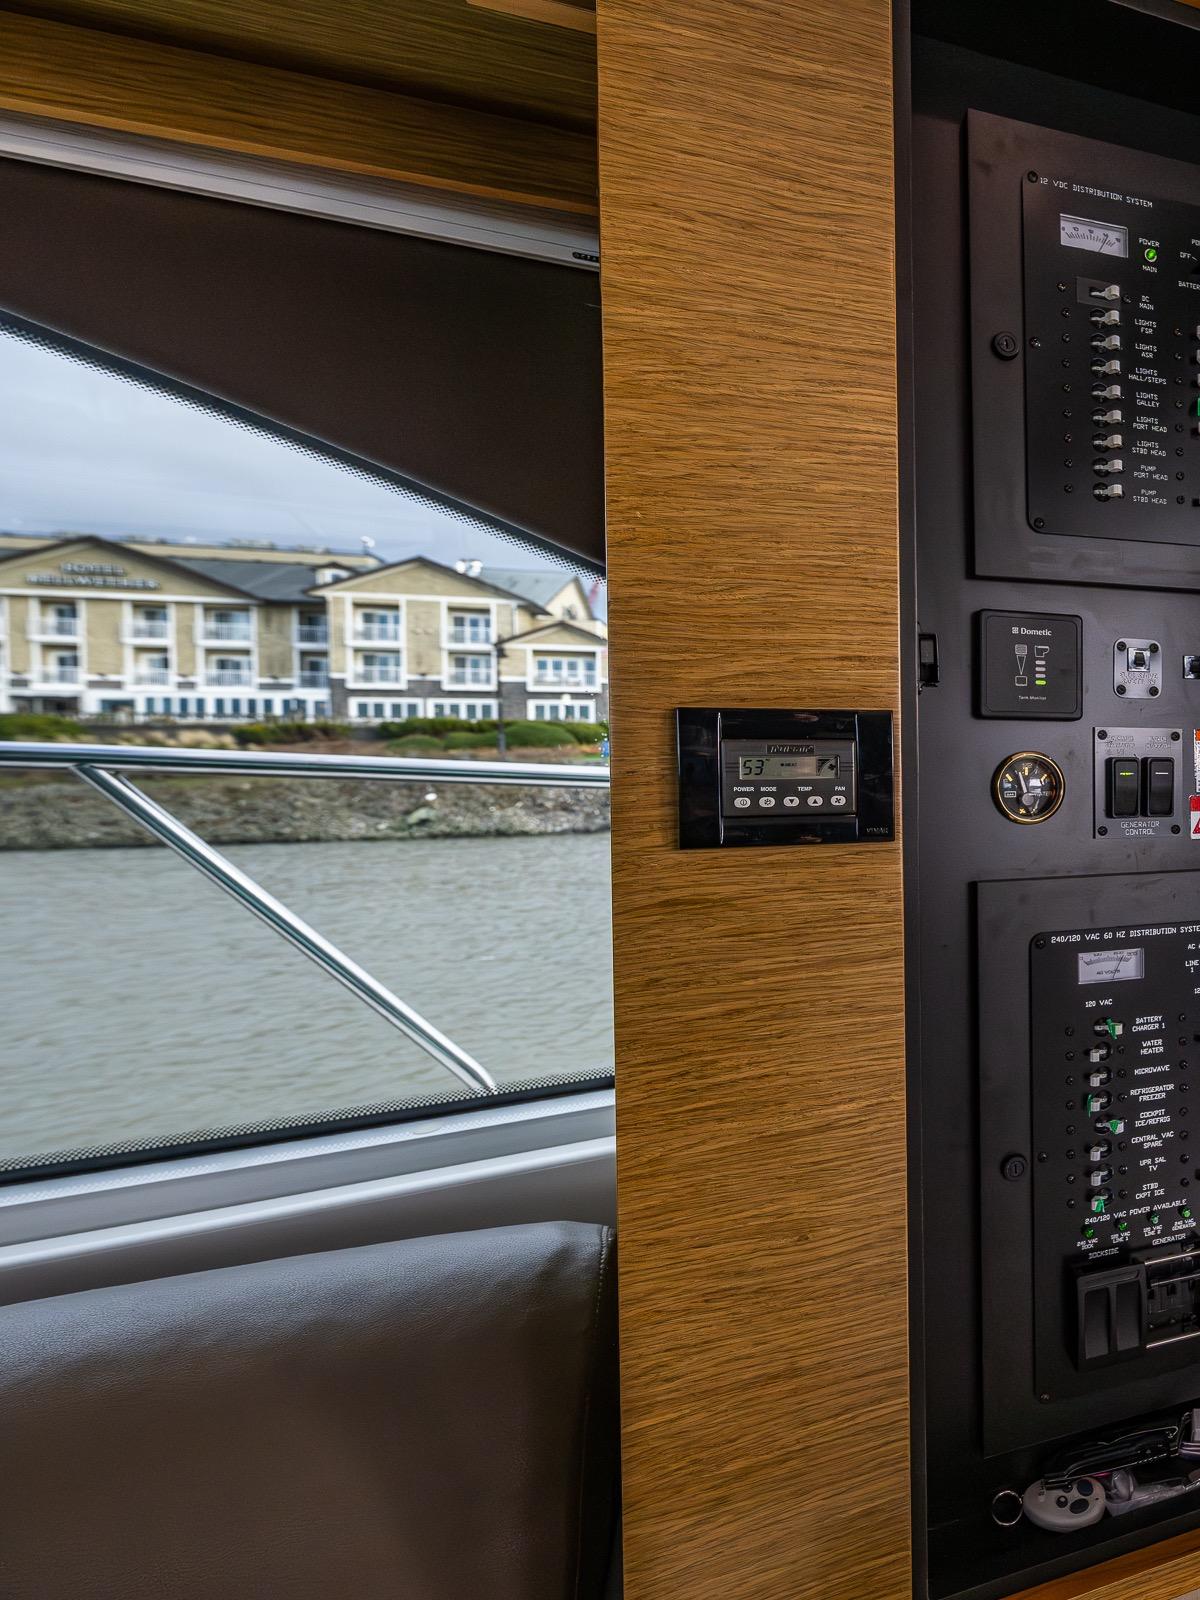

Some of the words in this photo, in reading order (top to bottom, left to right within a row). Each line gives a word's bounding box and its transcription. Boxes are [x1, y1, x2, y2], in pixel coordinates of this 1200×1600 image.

[1054, 180, 1067, 189] VDC
[1073, 184, 1122, 200] DISTRIBUTION
[1127, 196, 1152, 208] SYSTEM
[1139, 238, 1159, 247] POWER
[1135, 319, 1156, 328] LIGHTS
[1135, 343, 1157, 352] LIGHTS
[1136, 368, 1158, 376] LIGHTS
[1129, 374, 1166, 385] HALL/STEPS
[1136, 416, 1158, 424] LIGHTS
[1021, 628, 1052, 636] Dometic
[1121, 821, 1159, 829] GENERATOR
[1125, 828, 1155, 836] CONTROL
[1051, 934, 1080, 943] 240/120
[1130, 927, 1177, 937] DISTRIBUTION
[1136, 1016, 1163, 1024] BATTERY
[1132, 1024, 1159, 1032] CHARGER
[1141, 1047, 1164, 1055] HEATER
[1135, 1065, 1170, 1075] MICROWAVE
[1130, 1084, 1174, 1095] REFRIGERATOR
[1139, 1093, 1166, 1102] FREEZER
[1140, 1109, 1165, 1118] COCKPIT
[1132, 1135, 1158, 1143] CENTRAL
[1144, 1140, 1163, 1148] SPARE
[1113, 1211, 1126, 1219] VAC
[1129, 1207, 1150, 1216] POWER
[1153, 1199, 1187, 1211] AVAILABLE
[1153, 1233, 1186, 1245] GENERATOR
